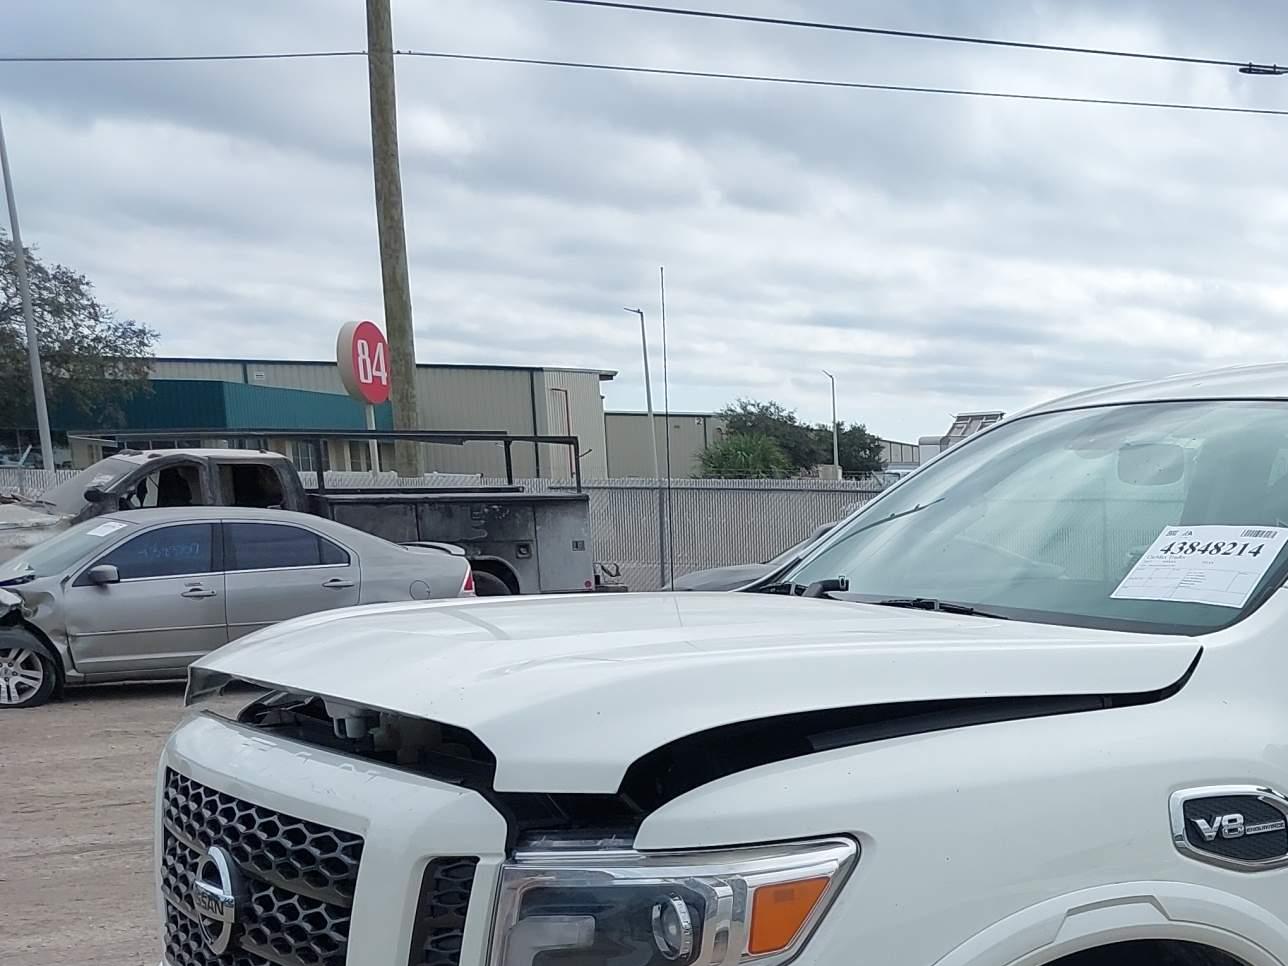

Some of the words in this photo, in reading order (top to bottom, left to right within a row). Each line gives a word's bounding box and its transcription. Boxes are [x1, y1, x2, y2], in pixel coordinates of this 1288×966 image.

[357, 339, 388, 386] 84
[1159, 541, 1265, 558] 43848214
[1189, 813, 1245, 841] V8
